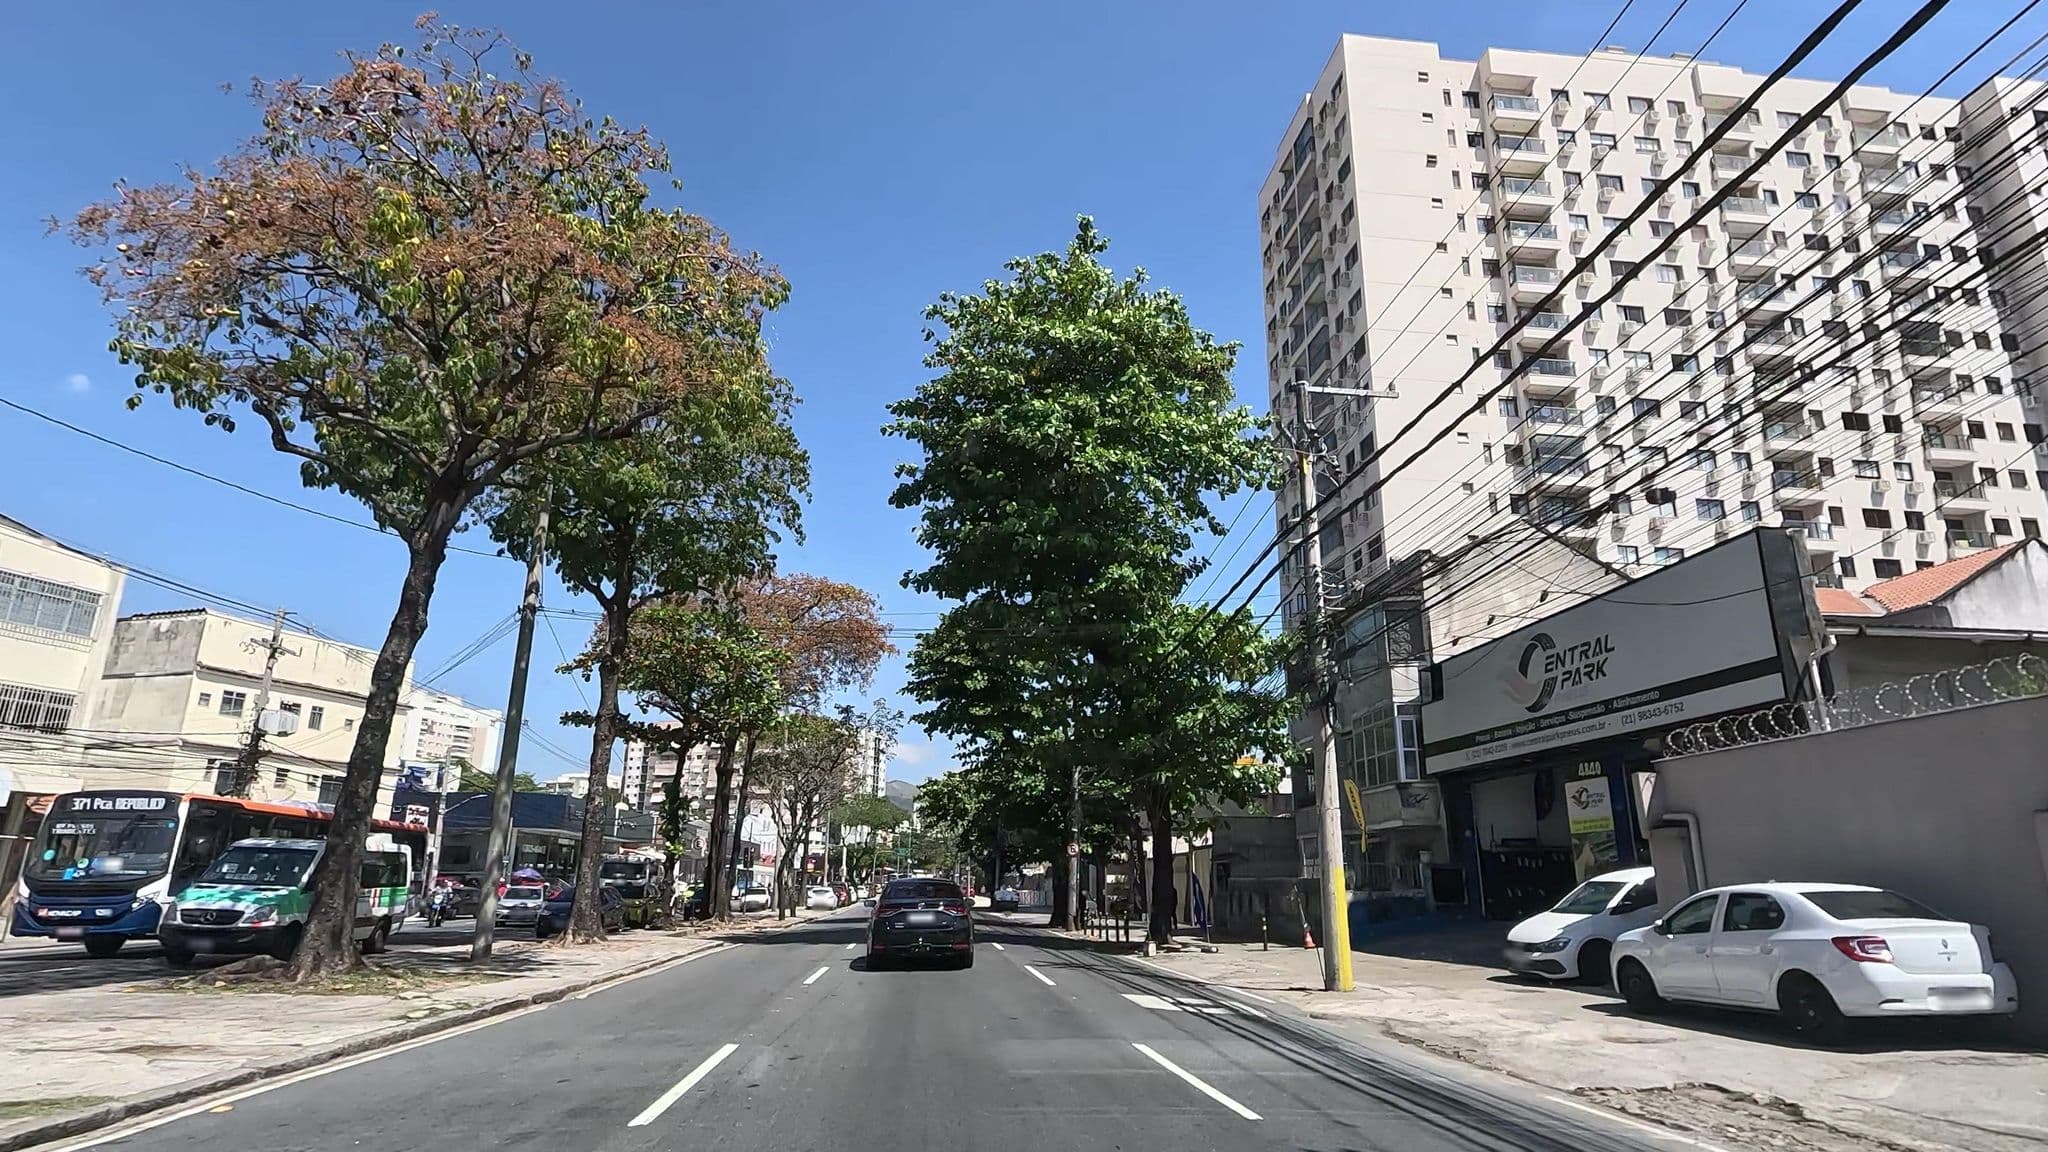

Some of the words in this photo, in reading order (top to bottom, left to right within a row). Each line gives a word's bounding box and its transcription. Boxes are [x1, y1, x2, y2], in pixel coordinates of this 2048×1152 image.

[1561, 657, 1609, 690] PARK
[1621, 713, 1636, 727] (21)
[71, 797, 91, 811] 371
